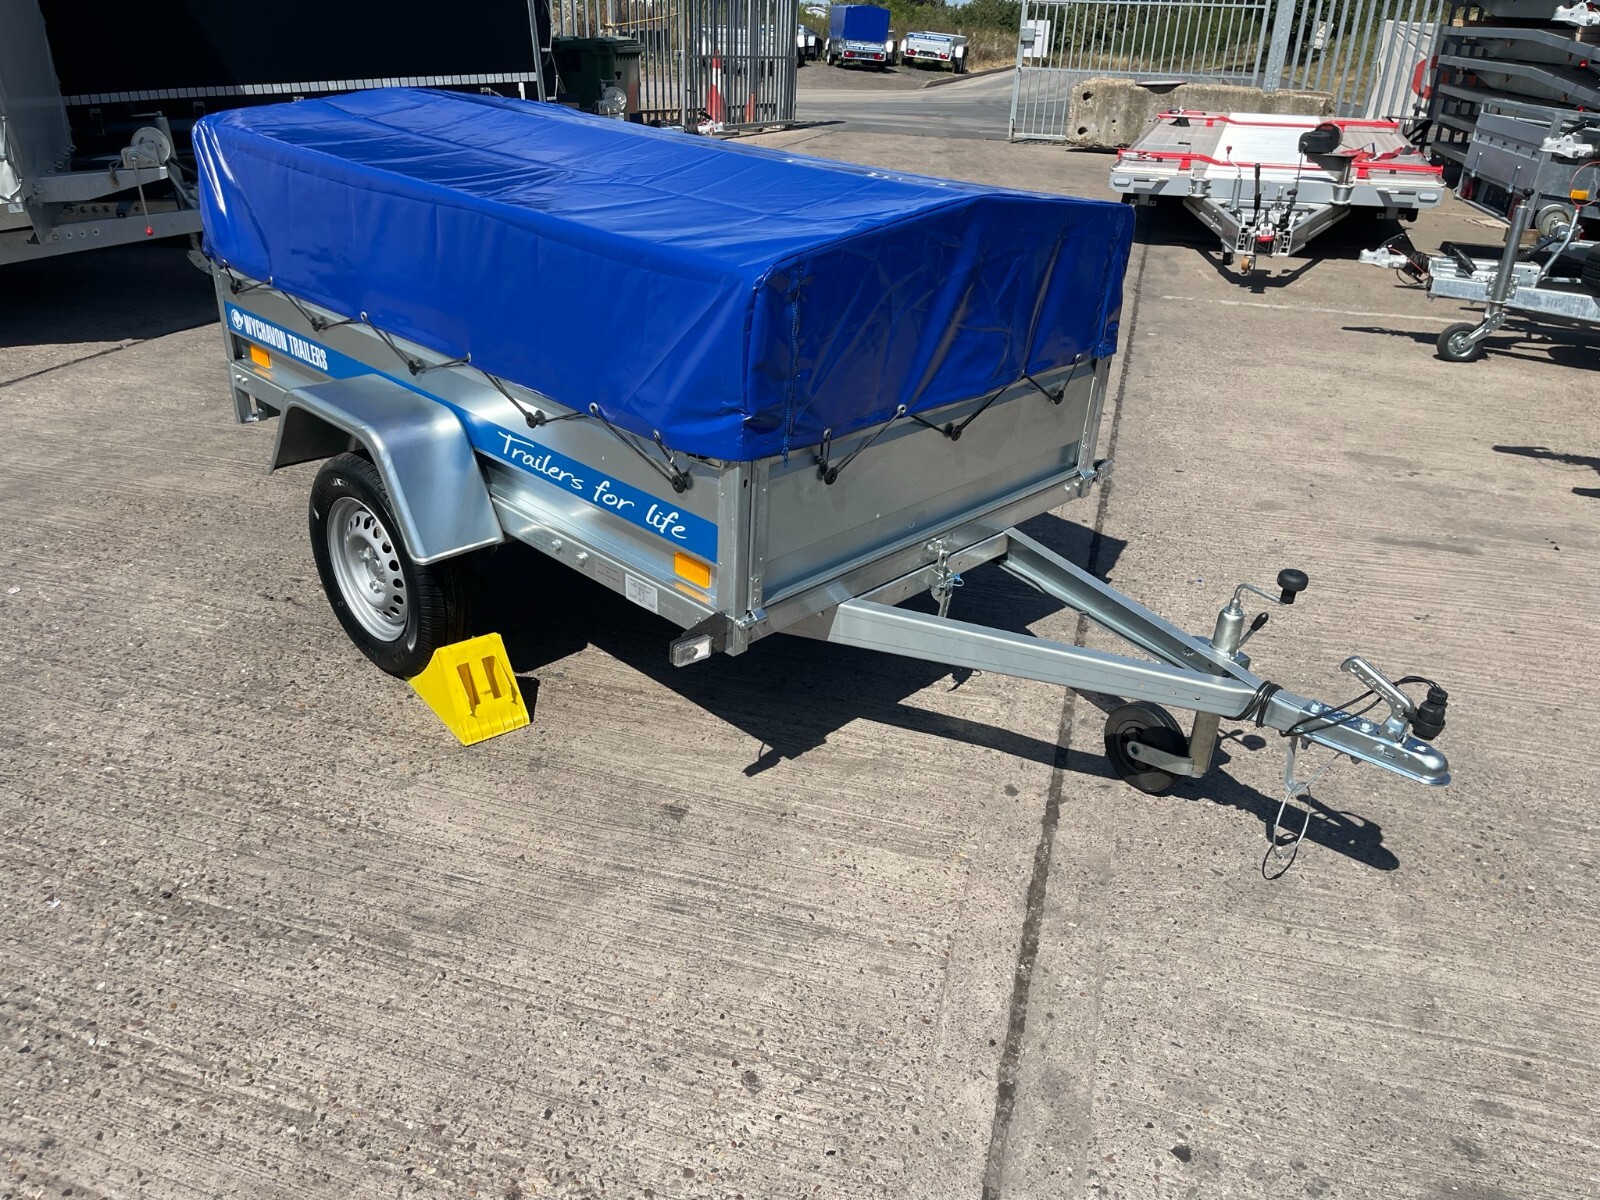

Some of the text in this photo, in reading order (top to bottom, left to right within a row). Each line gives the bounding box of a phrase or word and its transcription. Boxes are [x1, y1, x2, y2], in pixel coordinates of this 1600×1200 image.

[243, 314, 328, 371] WYCHAVON TRAILERS
[498, 431, 688, 539] Trailers for life
